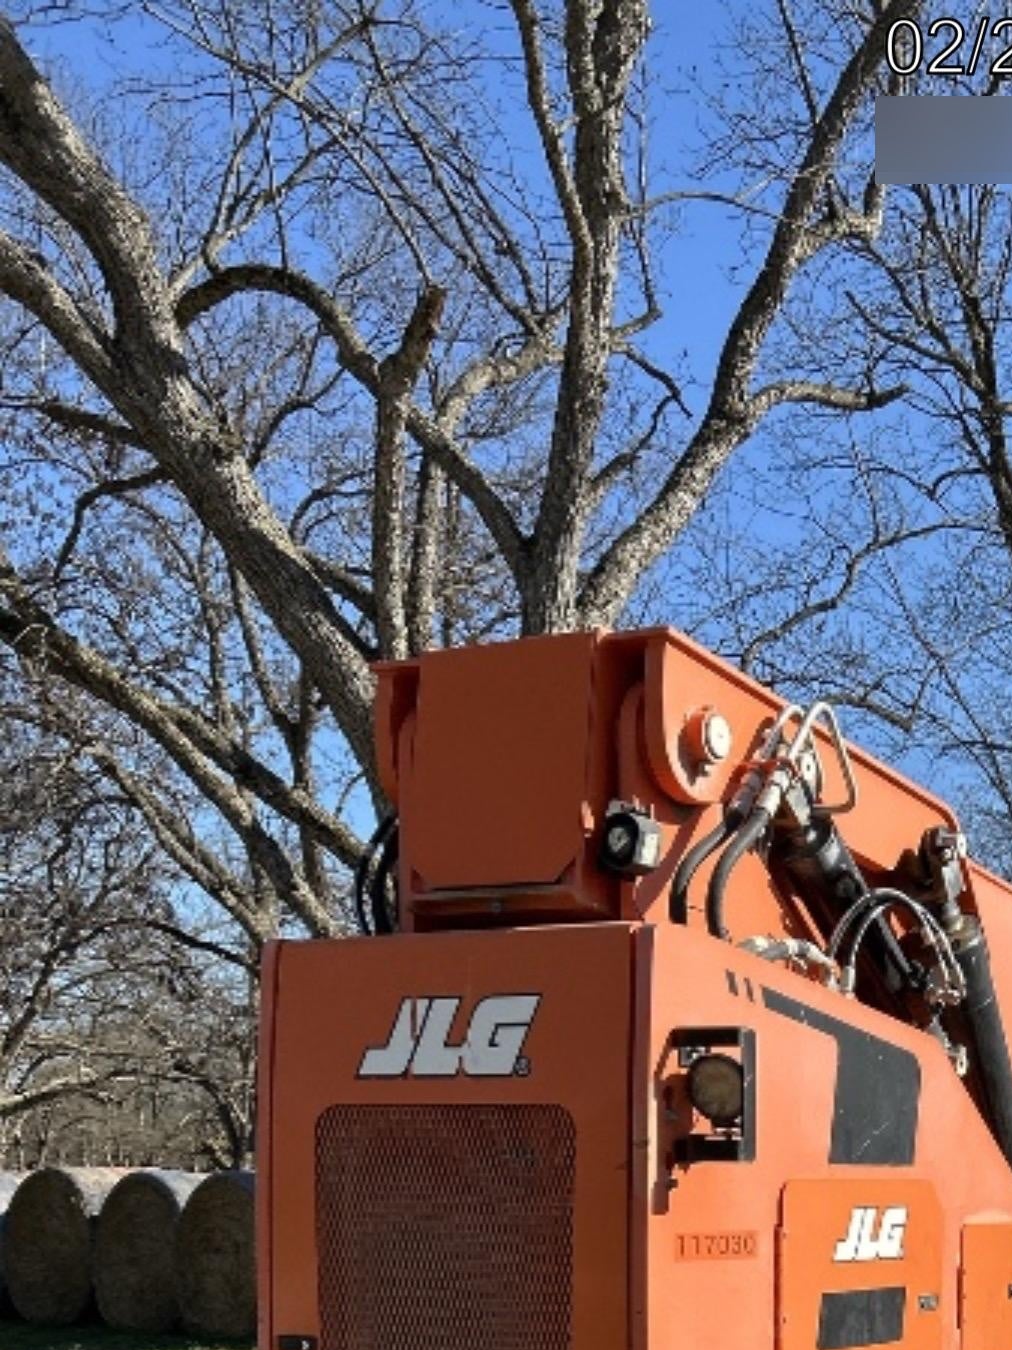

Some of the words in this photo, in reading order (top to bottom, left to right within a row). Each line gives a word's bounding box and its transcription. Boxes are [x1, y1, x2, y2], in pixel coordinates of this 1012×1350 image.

[356, 992, 543, 1078] JLG
[677, 1233, 757, 1257] 117030
[832, 1205, 909, 1263] JLG
